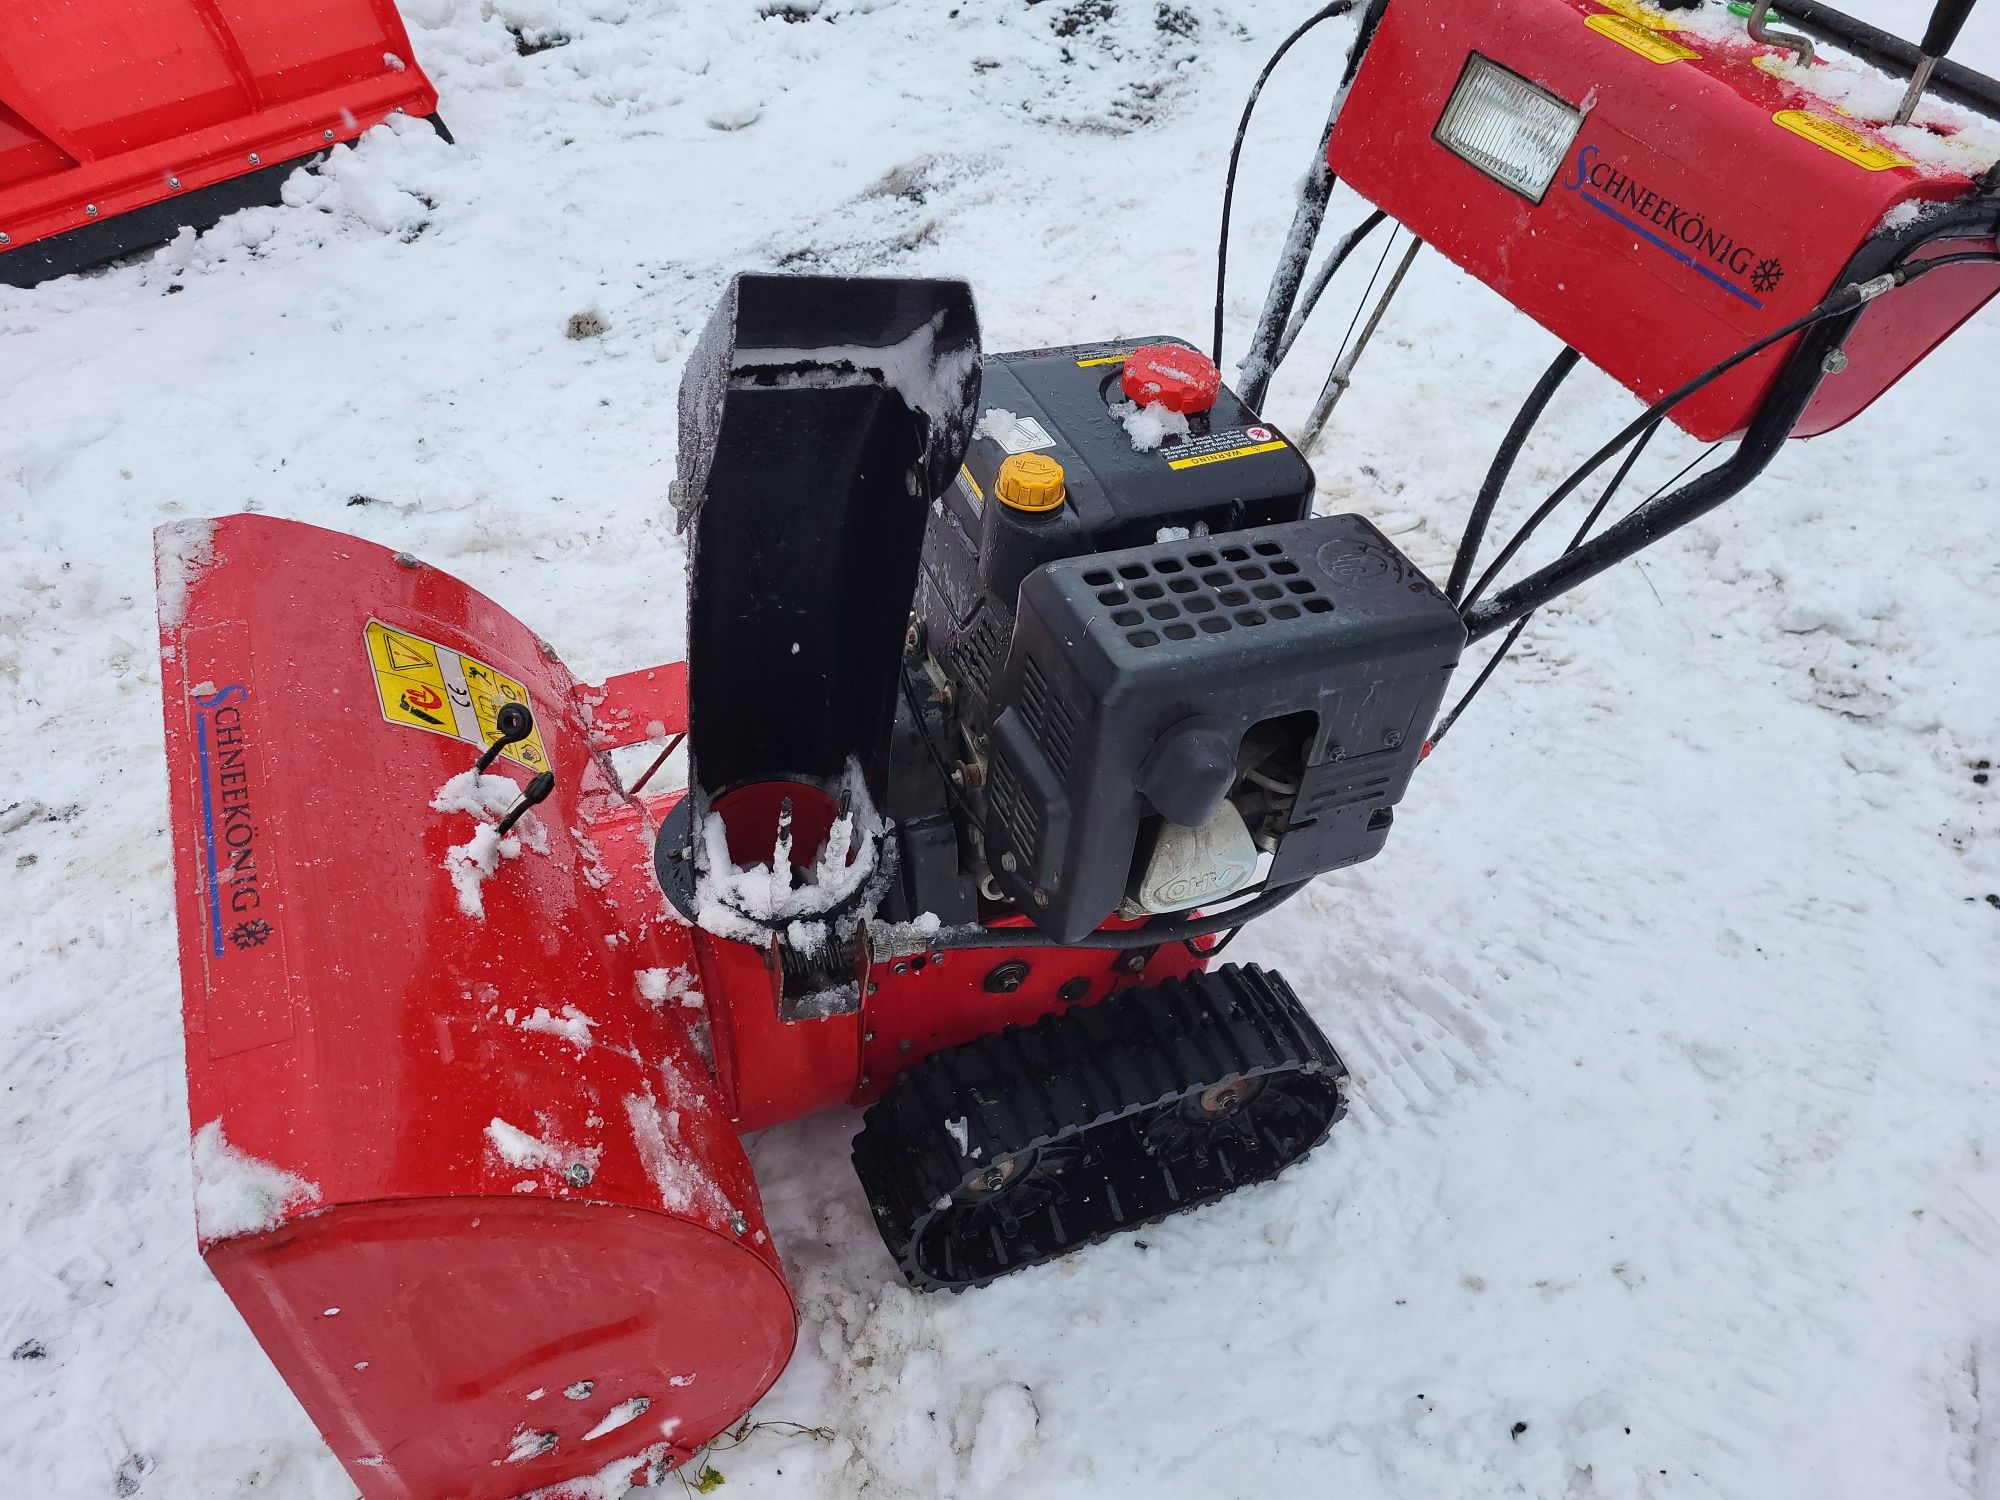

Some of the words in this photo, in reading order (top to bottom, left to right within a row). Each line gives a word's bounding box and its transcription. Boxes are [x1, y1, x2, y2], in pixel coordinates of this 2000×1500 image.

[1803, 121, 1855, 149] Achtung
[1564, 144, 1756, 276] SCHNEEKÖNIG
[1190, 450, 1240, 464] WARNING
[1231, 440, 1252, 448] Check
[195, 683, 262, 914] SCHNEEKÖNIG
[1166, 867, 1232, 900] OHV
